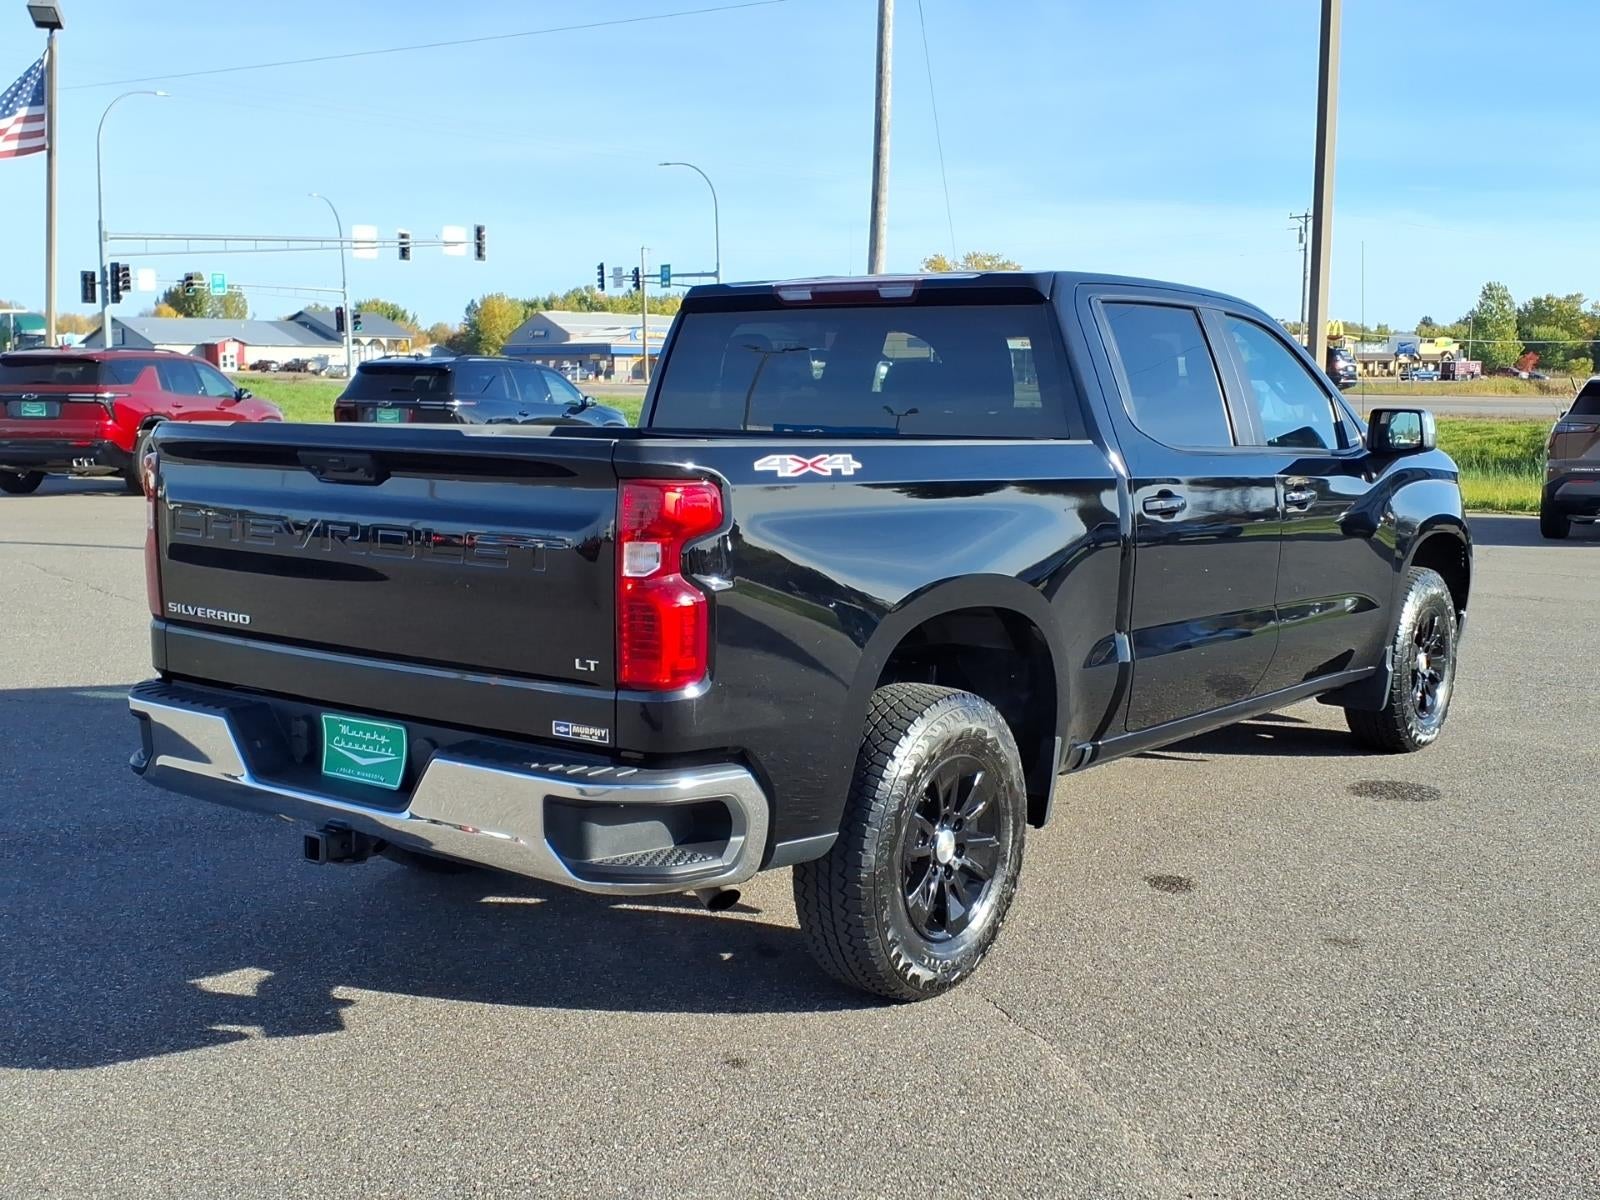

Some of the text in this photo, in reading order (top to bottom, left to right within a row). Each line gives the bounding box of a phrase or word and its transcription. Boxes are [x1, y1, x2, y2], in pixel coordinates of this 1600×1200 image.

[172, 505, 574, 572] CHEVROLET
[167, 602, 251, 625] SILVERADO
[575, 658, 600, 672] LT
[338, 723, 390, 744] Murphy
[572, 726, 606, 737] MURPHY
[333, 736, 396, 756] Chevrolet
